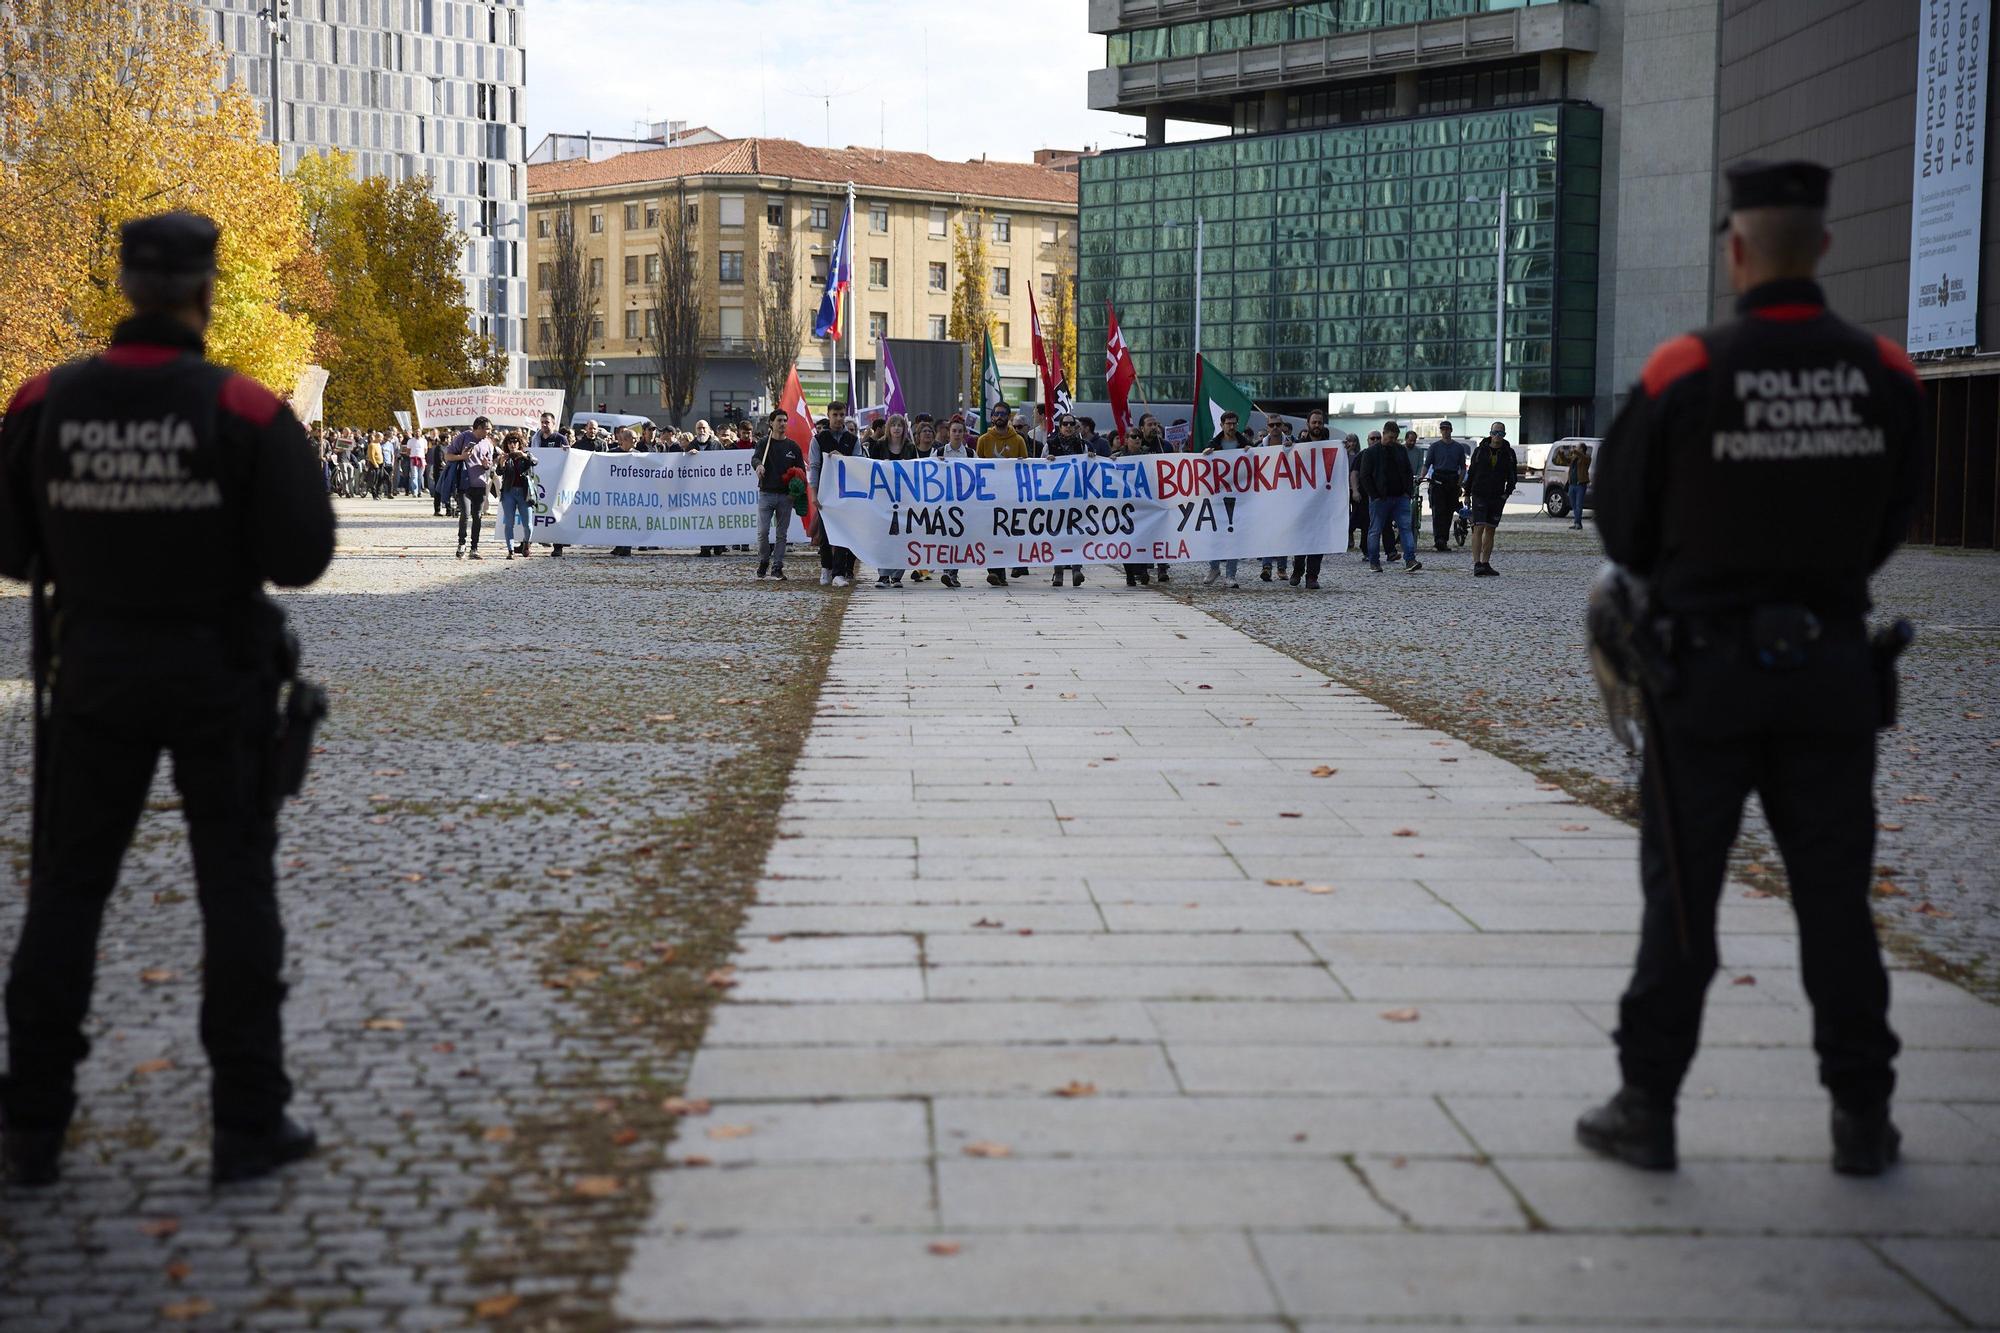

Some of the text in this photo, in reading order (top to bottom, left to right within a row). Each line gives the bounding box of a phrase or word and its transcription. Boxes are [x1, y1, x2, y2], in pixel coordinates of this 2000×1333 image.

[1936, 85, 1946, 128] los
[1966, 12, 1980, 167] artistikoa
[1922, 46, 1936, 178] Memoria
[1934, 136, 1944, 174] de
[1734, 361, 1870, 398] POLICÍA
[425, 406, 478, 418] IKASLEOK
[427, 395, 545, 407] LANBIDE HEZIKETAKO
[1745, 399, 1862, 427] FORAL
[59, 414, 196, 450] POLICÍA
[610, 463, 752, 479] Profesorado técnico de F.P.
[1156, 447, 1338, 500] BORROKAN!
[605, 491, 663, 508] TRABAJO,
[668, 491, 717, 508] MISMAS
[889, 497, 1236, 537] ¡MÁS RECURSOS YA!
[578, 514, 601, 529] LAN
[606, 515, 641, 531] BERA,
[646, 515, 714, 531] BALDINTZA
[907, 541, 985, 566] STEILAS
[1018, 542, 1054, 562] LAB
[1083, 542, 1131, 560] CCOO
[1153, 539, 1190, 559] ELA
